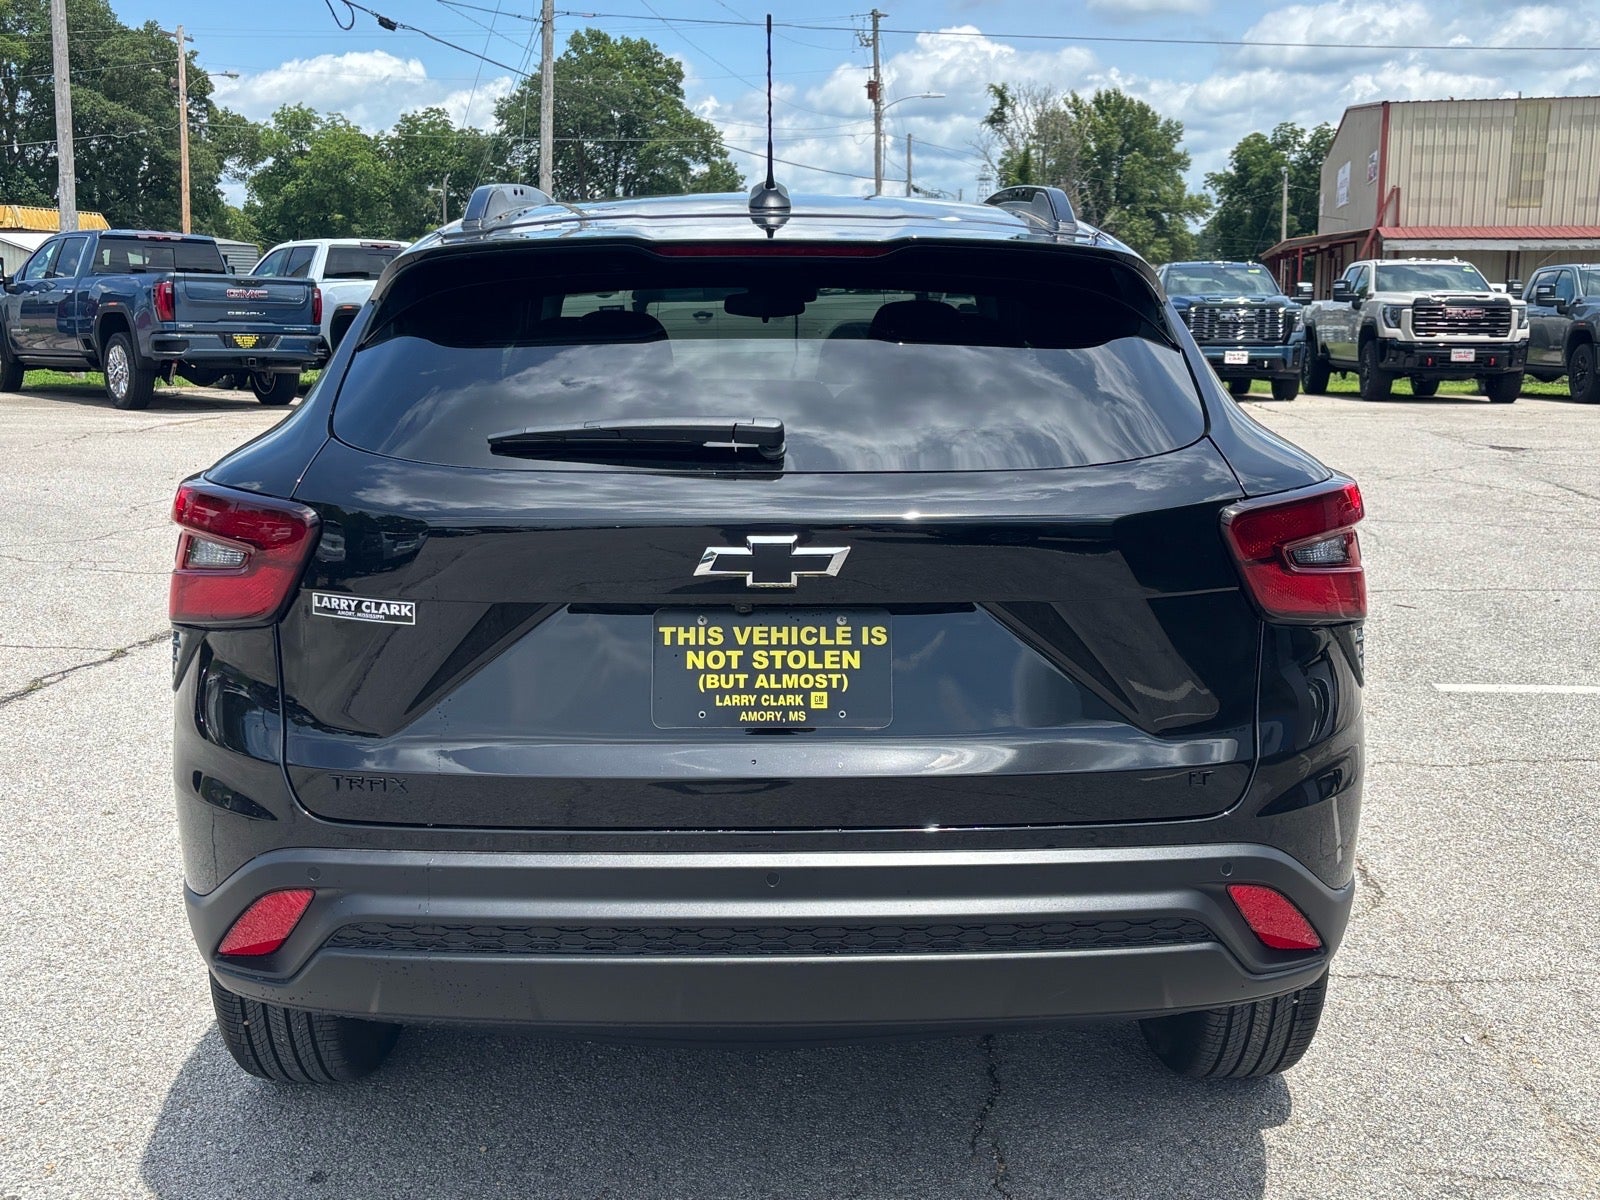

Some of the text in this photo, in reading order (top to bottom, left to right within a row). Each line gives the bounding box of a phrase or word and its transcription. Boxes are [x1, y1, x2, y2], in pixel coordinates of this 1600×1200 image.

[226, 288, 268, 299] GMC
[1443, 308, 1485, 319] GMC
[314, 595, 413, 617] LARRY CLARK
[658, 626, 888, 646] THIS VEHICLE IS
[686, 650, 861, 670] NOT STOLEN
[698, 674, 849, 693] (BUT ALMOST)
[715, 694, 825, 707] LARRY CLARK GM
[739, 711, 807, 723] AMORY, MS
[328, 774, 408, 793] TRAX
